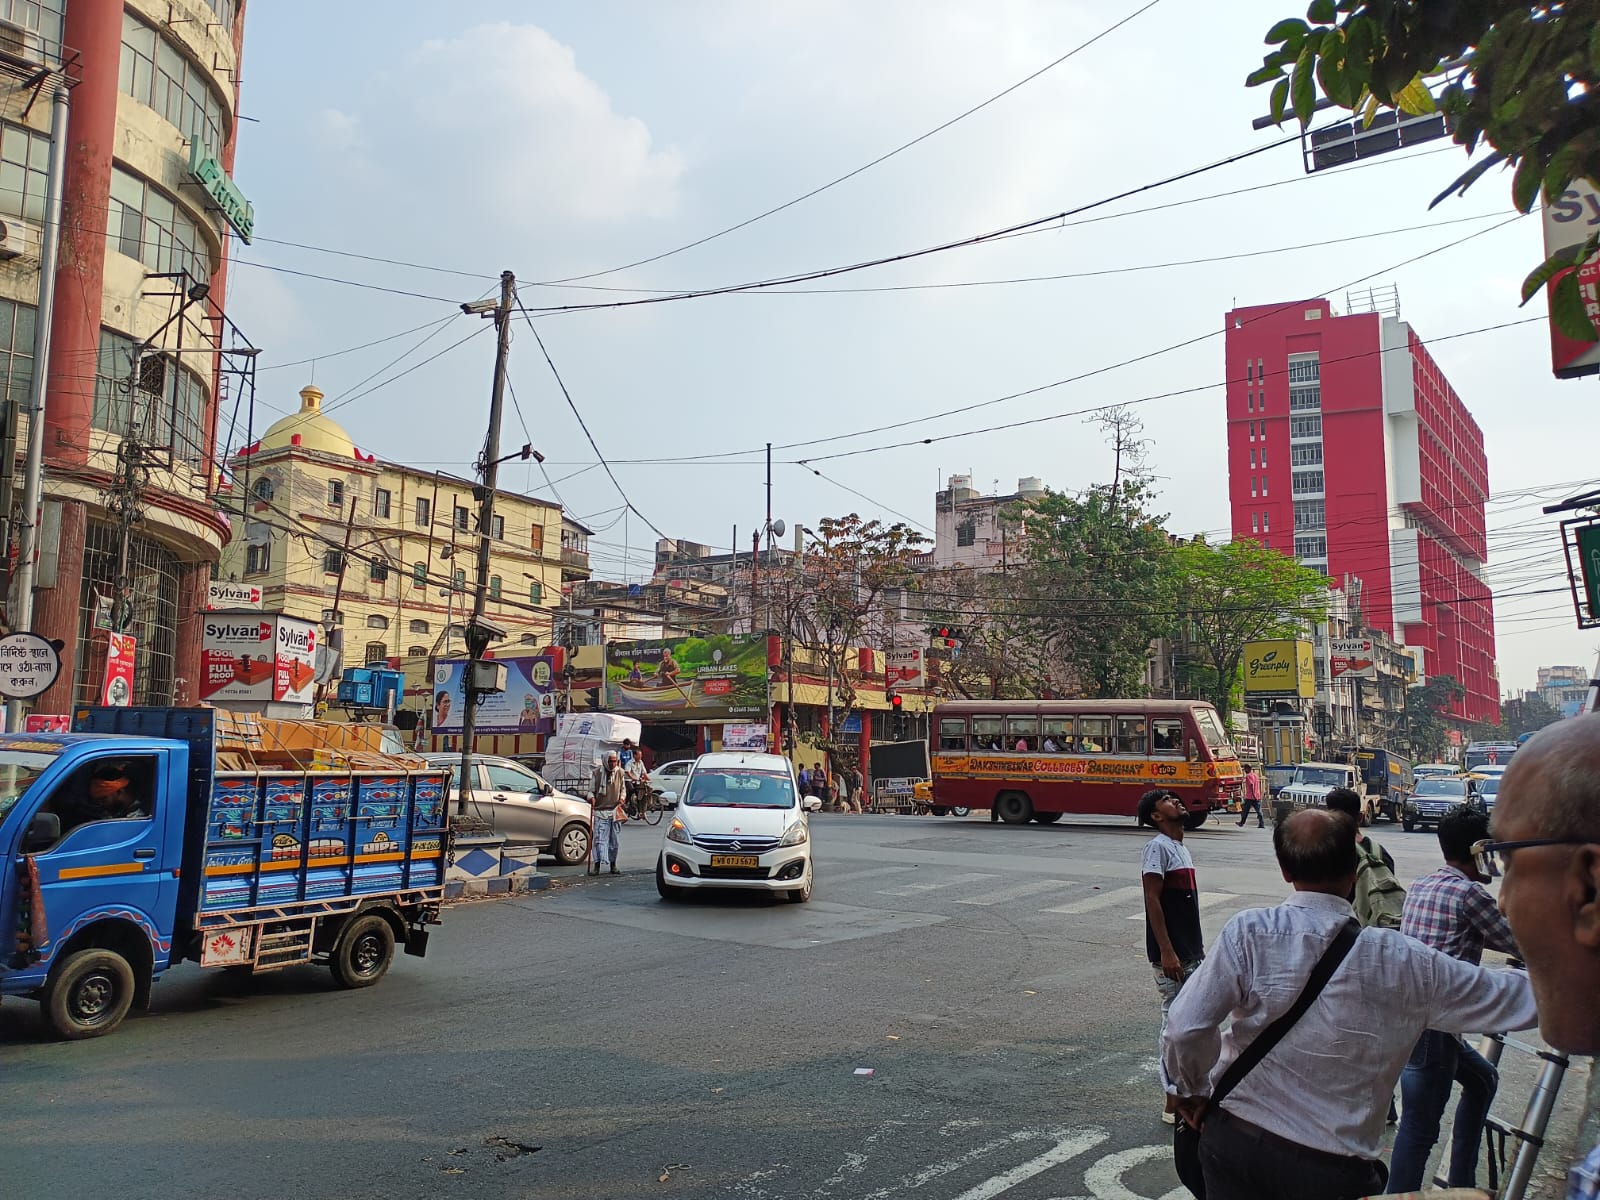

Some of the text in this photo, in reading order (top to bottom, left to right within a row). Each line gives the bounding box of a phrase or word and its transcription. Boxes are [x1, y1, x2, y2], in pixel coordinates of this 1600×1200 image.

[209, 586, 251, 600] Sylvan
[206, 624, 260, 640] Sylvan
[260, 628, 271, 637] ply
[280, 626, 308, 648] Sylvan
[1332, 642, 1363, 651] Sylvan
[208, 649, 234, 657] FOOL
[886, 651, 913, 661] Sylvan
[17, 661, 52, 672] ওঠা-নামা
[208, 664, 234, 673] FULL
[697, 664, 738, 673] URBAN LAKES
[1250, 658, 1290, 676] Greenply
[208, 672, 235, 680] PROOF
